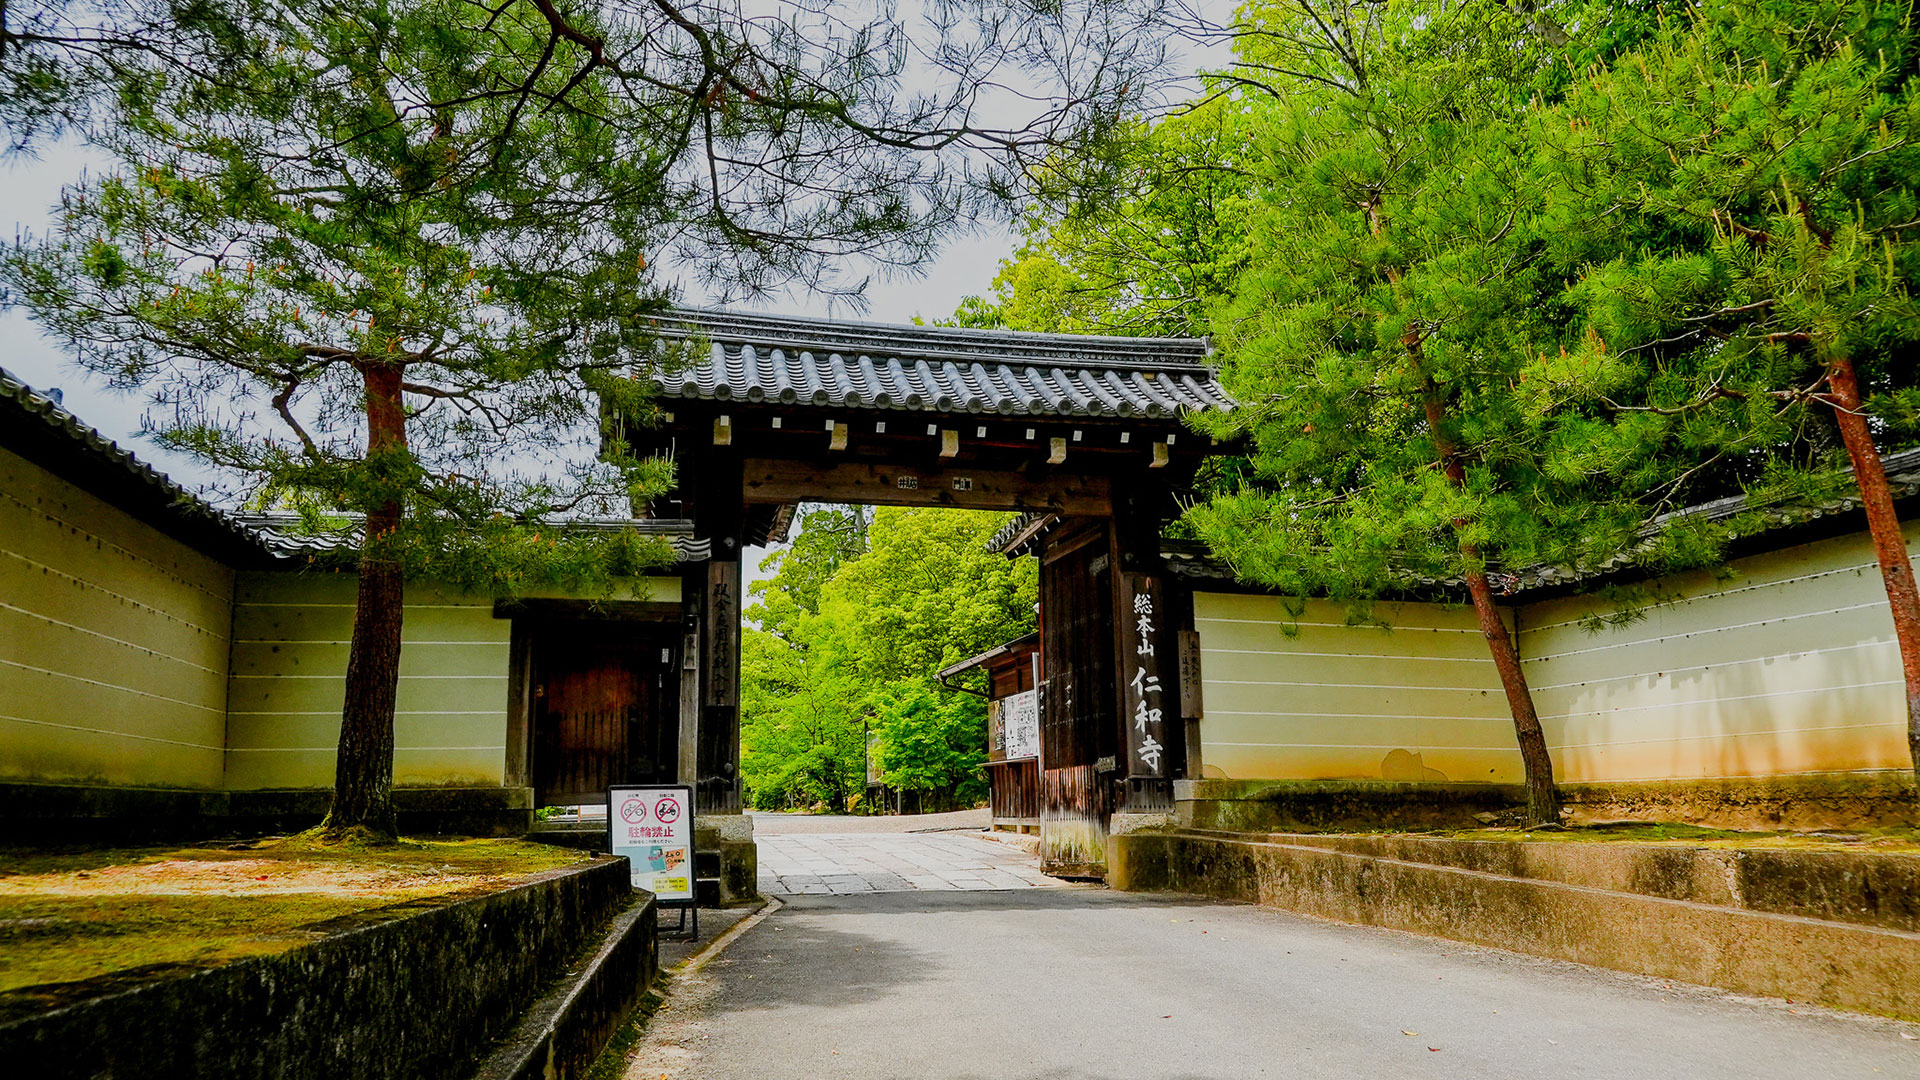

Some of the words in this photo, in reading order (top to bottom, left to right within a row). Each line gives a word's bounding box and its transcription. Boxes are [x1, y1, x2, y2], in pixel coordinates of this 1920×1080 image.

[1133, 593, 1155, 657] 総本山
[1130, 667, 1163, 774] 仁和寺
[628, 826, 675, 838] 駐輪禁止
